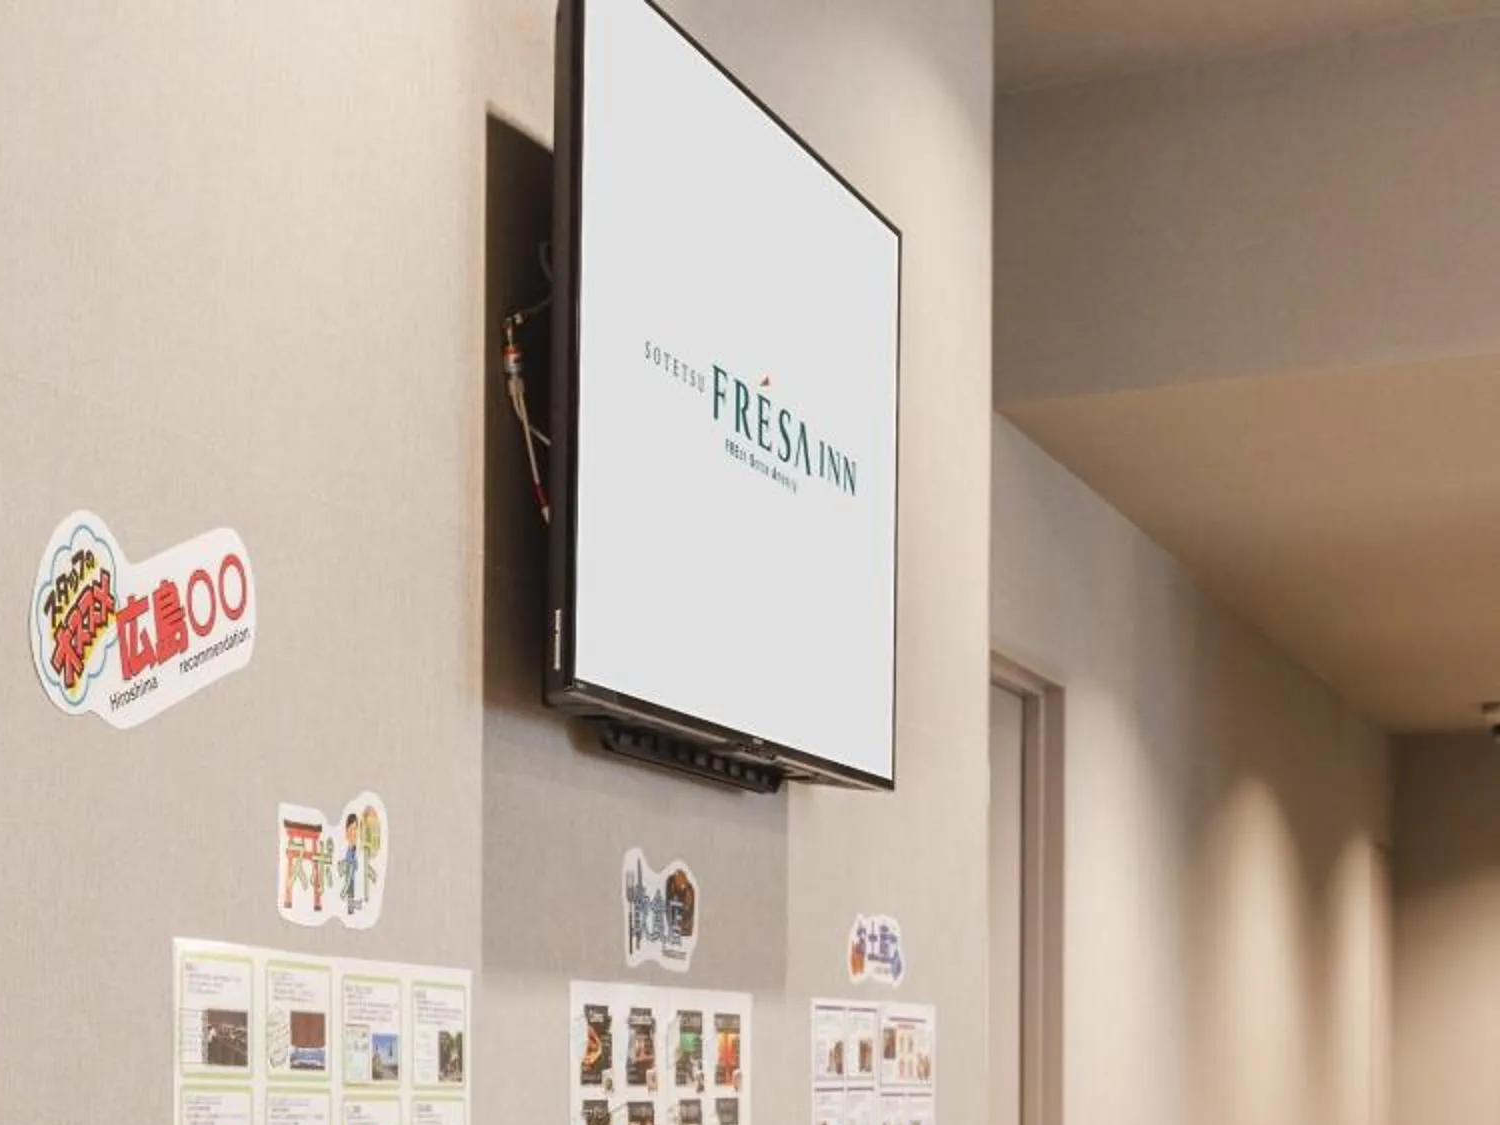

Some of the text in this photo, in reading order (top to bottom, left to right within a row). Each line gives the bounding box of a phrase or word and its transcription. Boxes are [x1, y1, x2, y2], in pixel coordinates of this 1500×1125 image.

[644, 340, 706, 393] SOTETSU
[818, 440, 857, 496] INN
[109, 626, 251, 711] Hiroshima recommendation
